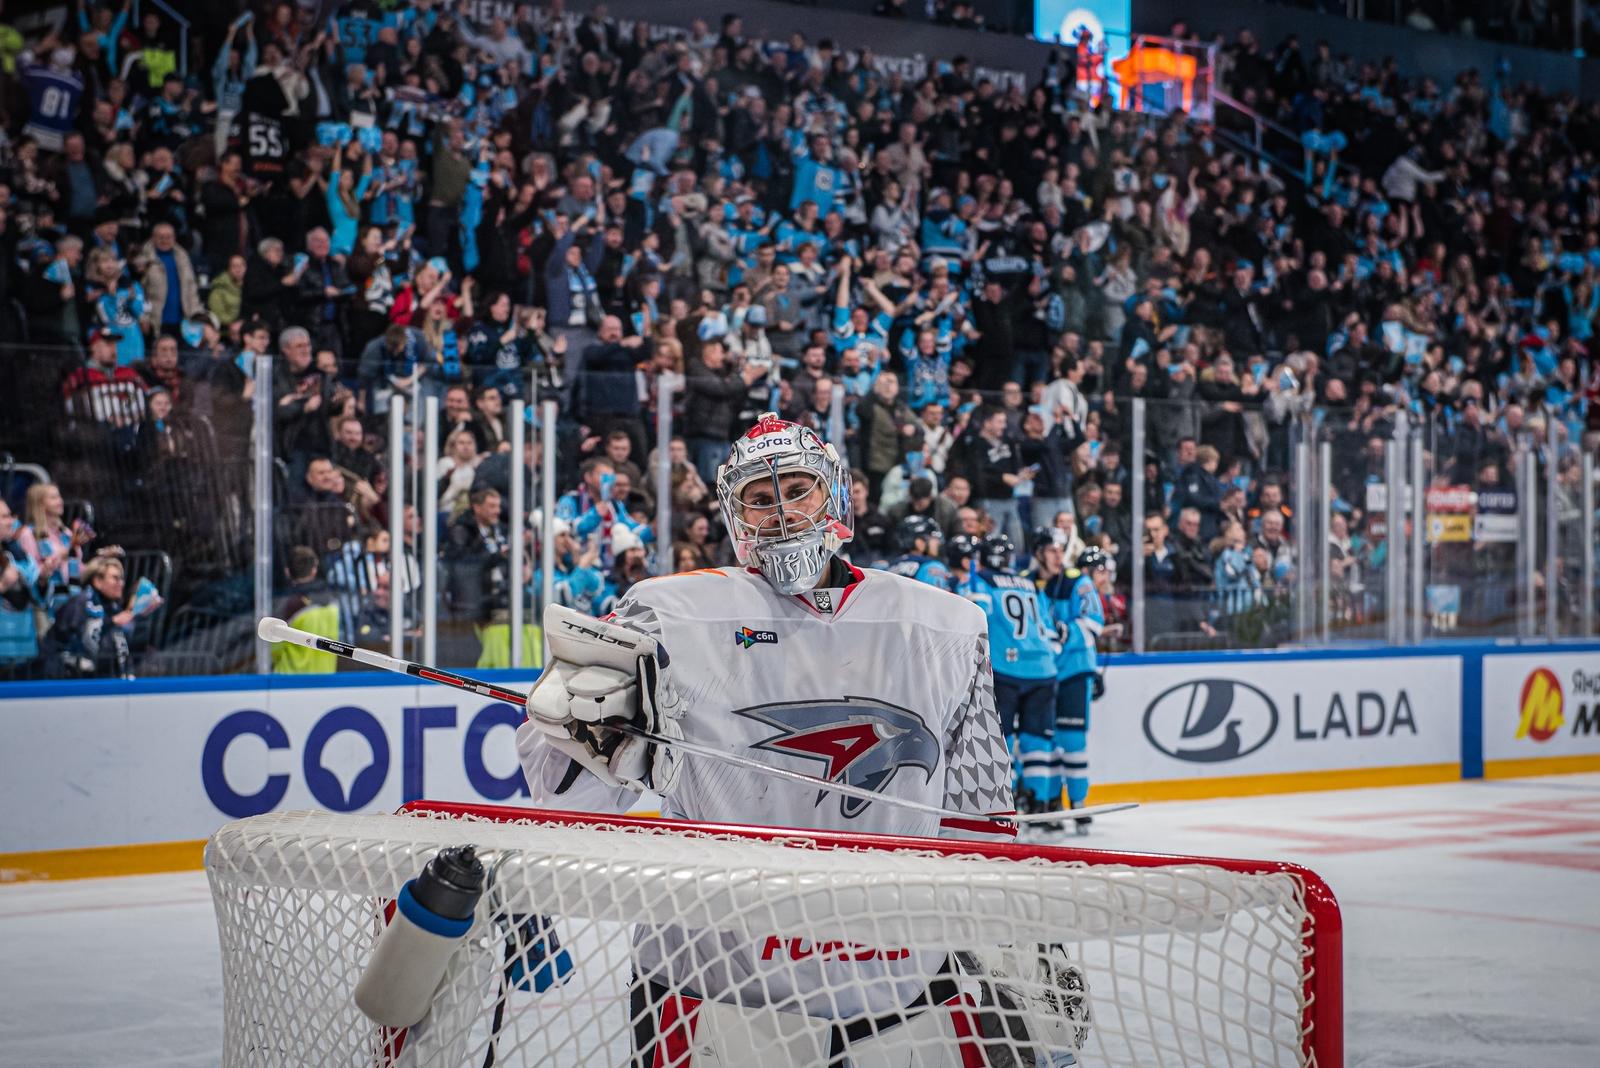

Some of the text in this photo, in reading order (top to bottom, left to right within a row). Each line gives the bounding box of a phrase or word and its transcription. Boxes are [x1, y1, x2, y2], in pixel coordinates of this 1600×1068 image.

[747, 436, 792, 453] согаз
[562, 620, 637, 650] TRUE
[1001, 591, 1047, 640] 91
[756, 632, 774, 641] сбп
[1294, 689, 1418, 740] LADA
[201, 702, 533, 819] сога
